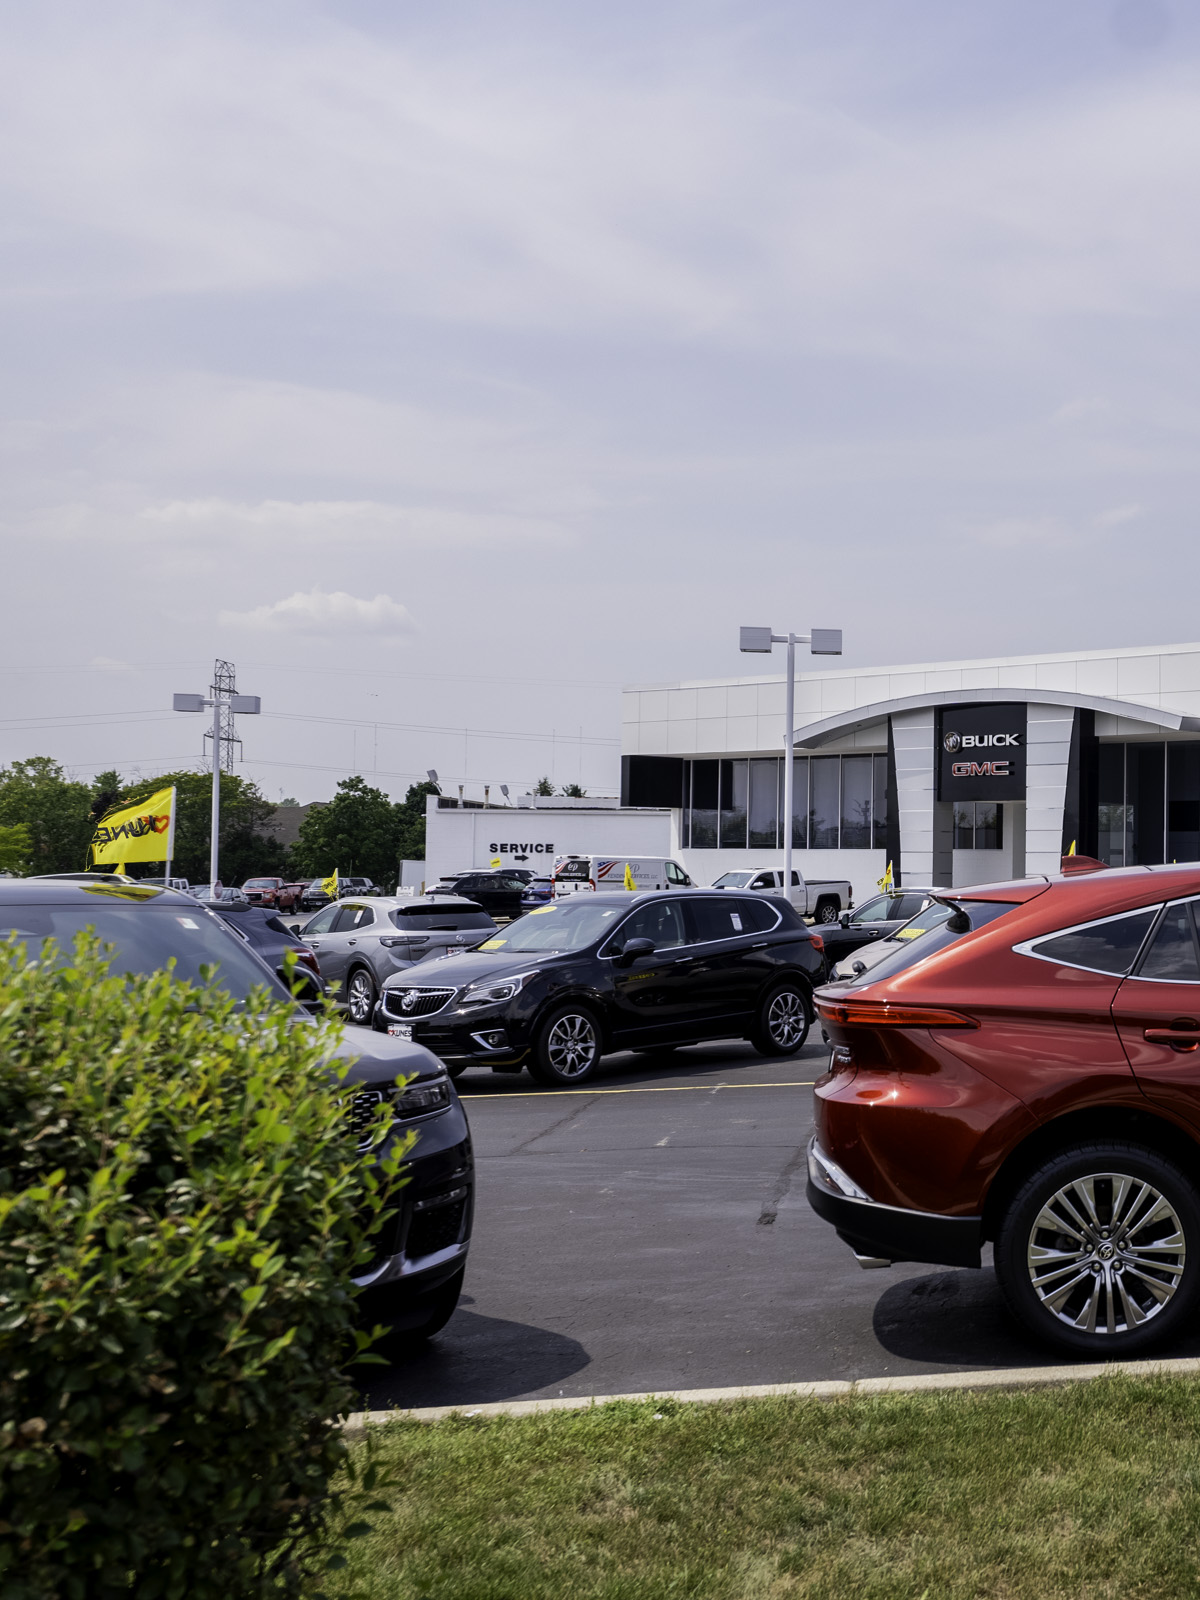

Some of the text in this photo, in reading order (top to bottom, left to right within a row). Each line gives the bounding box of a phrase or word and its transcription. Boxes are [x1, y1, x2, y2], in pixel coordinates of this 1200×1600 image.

[962, 734, 1020, 748] BUICK
[952, 761, 1009, 776] GMC
[489, 843, 554, 853] SERVICE
